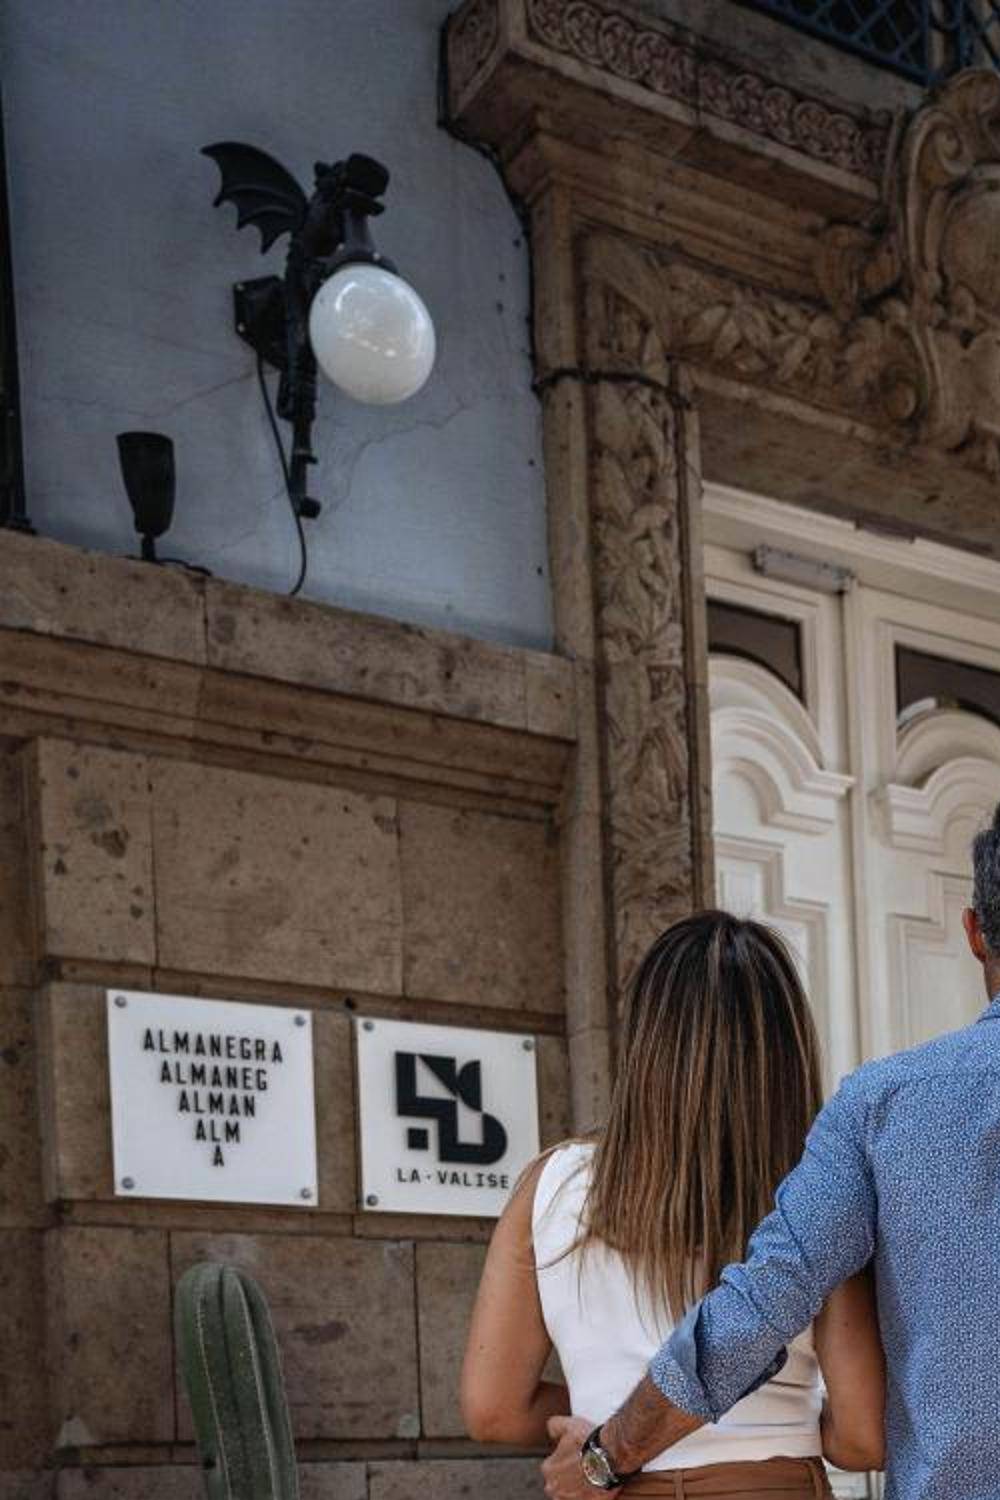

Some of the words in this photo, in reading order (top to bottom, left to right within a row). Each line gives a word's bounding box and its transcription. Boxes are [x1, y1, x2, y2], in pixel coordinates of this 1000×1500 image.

[142, 1028, 284, 1064] ALMANEGRA
[159, 1060, 269, 1092] ALMANEG
[176, 1090, 256, 1118] ALMAN
[194, 1118, 242, 1144] ALM
[212, 1145, 225, 1168] A
